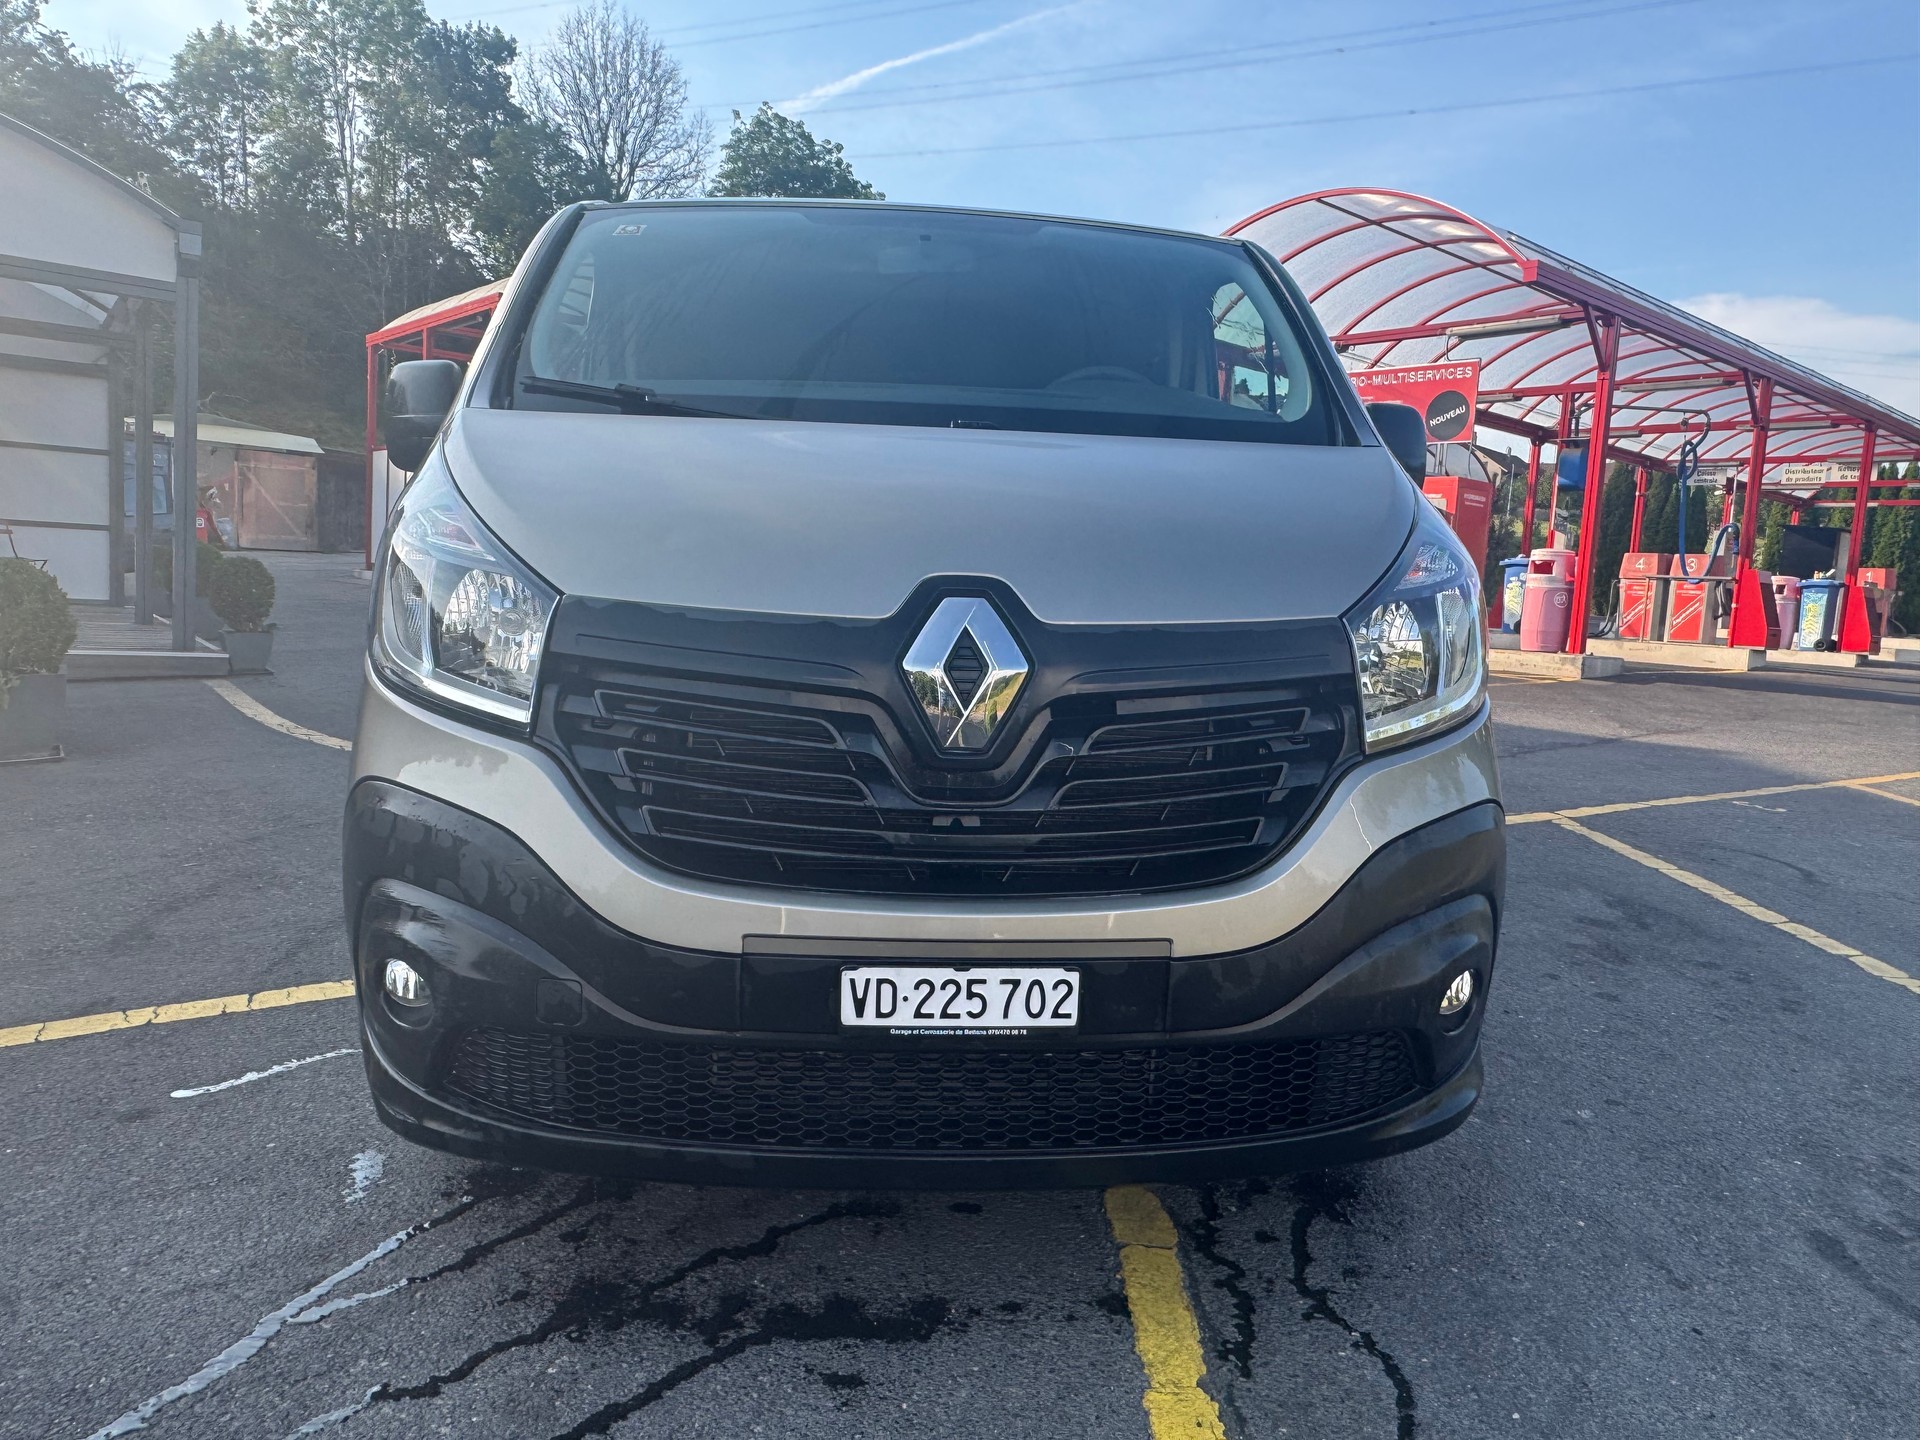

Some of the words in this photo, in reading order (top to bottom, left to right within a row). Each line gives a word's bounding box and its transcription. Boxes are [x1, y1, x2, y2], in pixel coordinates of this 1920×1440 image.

[1349, 366, 1473, 387] RO-MULTISERVICES
[1430, 405, 1466, 427] NOUVEAU
[1635, 557, 1645, 571] 4
[1686, 558, 1697, 572] 3
[1866, 571, 1873, 582] 1
[889, 1028, 912, 1036] Garage
